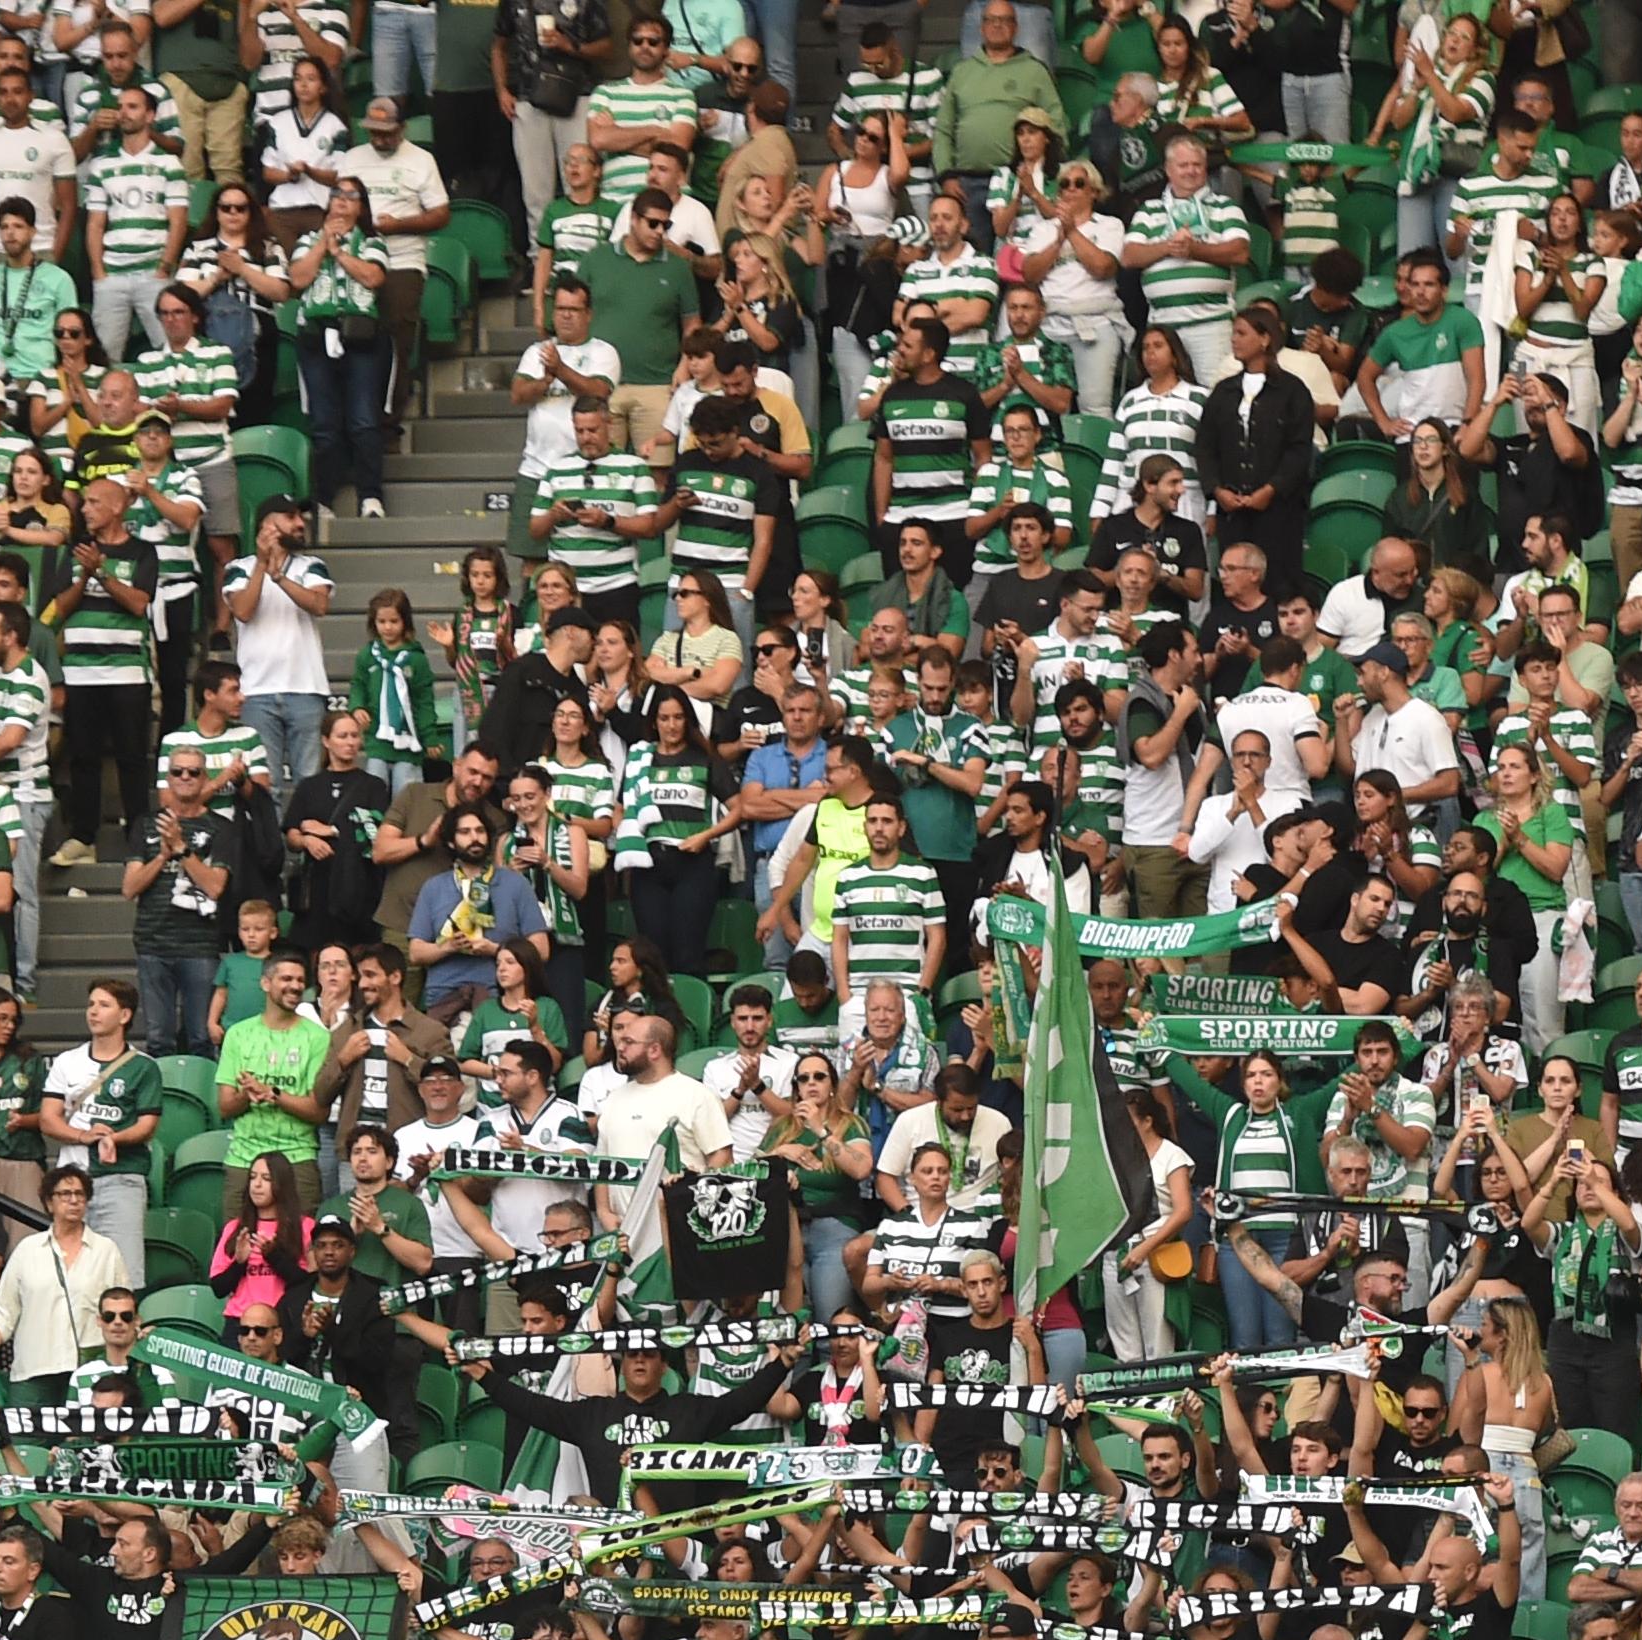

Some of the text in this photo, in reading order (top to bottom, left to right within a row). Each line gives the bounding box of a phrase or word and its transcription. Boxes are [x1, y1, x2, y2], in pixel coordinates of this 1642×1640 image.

[893, 423, 946, 439] Betano
[487, 492, 510, 510] 25
[327, 696, 349, 710] 22
[654, 782, 689, 800] tano
[854, 913, 904, 931] Betano
[1079, 918, 1196, 951] BICAMPEÃO
[1166, 974, 1277, 1006] SPORTING
[1164, 999, 1271, 1014] CLUBE DE PORTUGAL
[1199, 1020, 1339, 1040] SPORTING
[1209, 1037, 1327, 1049] CLUBE DE PORTUGAL
[250, 1069, 295, 1087] etano
[1111, 1061, 1138, 1078] ano
[708, 1209, 748, 1238] 120
[248, 1260, 274, 1277] etan
[146, 1334, 322, 1403] SPORTING CLUBE DE PORTUGAL
[1081, 1361, 1194, 1394] BRIGADA
[4, 1406, 212, 1438] BRIGAD
[120, 1446, 238, 1481] SPORTING
[632, 1585, 853, 1604] SPORTING ONDE ESTIVERES
[759, 1594, 982, 1625] BRIGADA
[1179, 1584, 1421, 1628] BRIGADA
